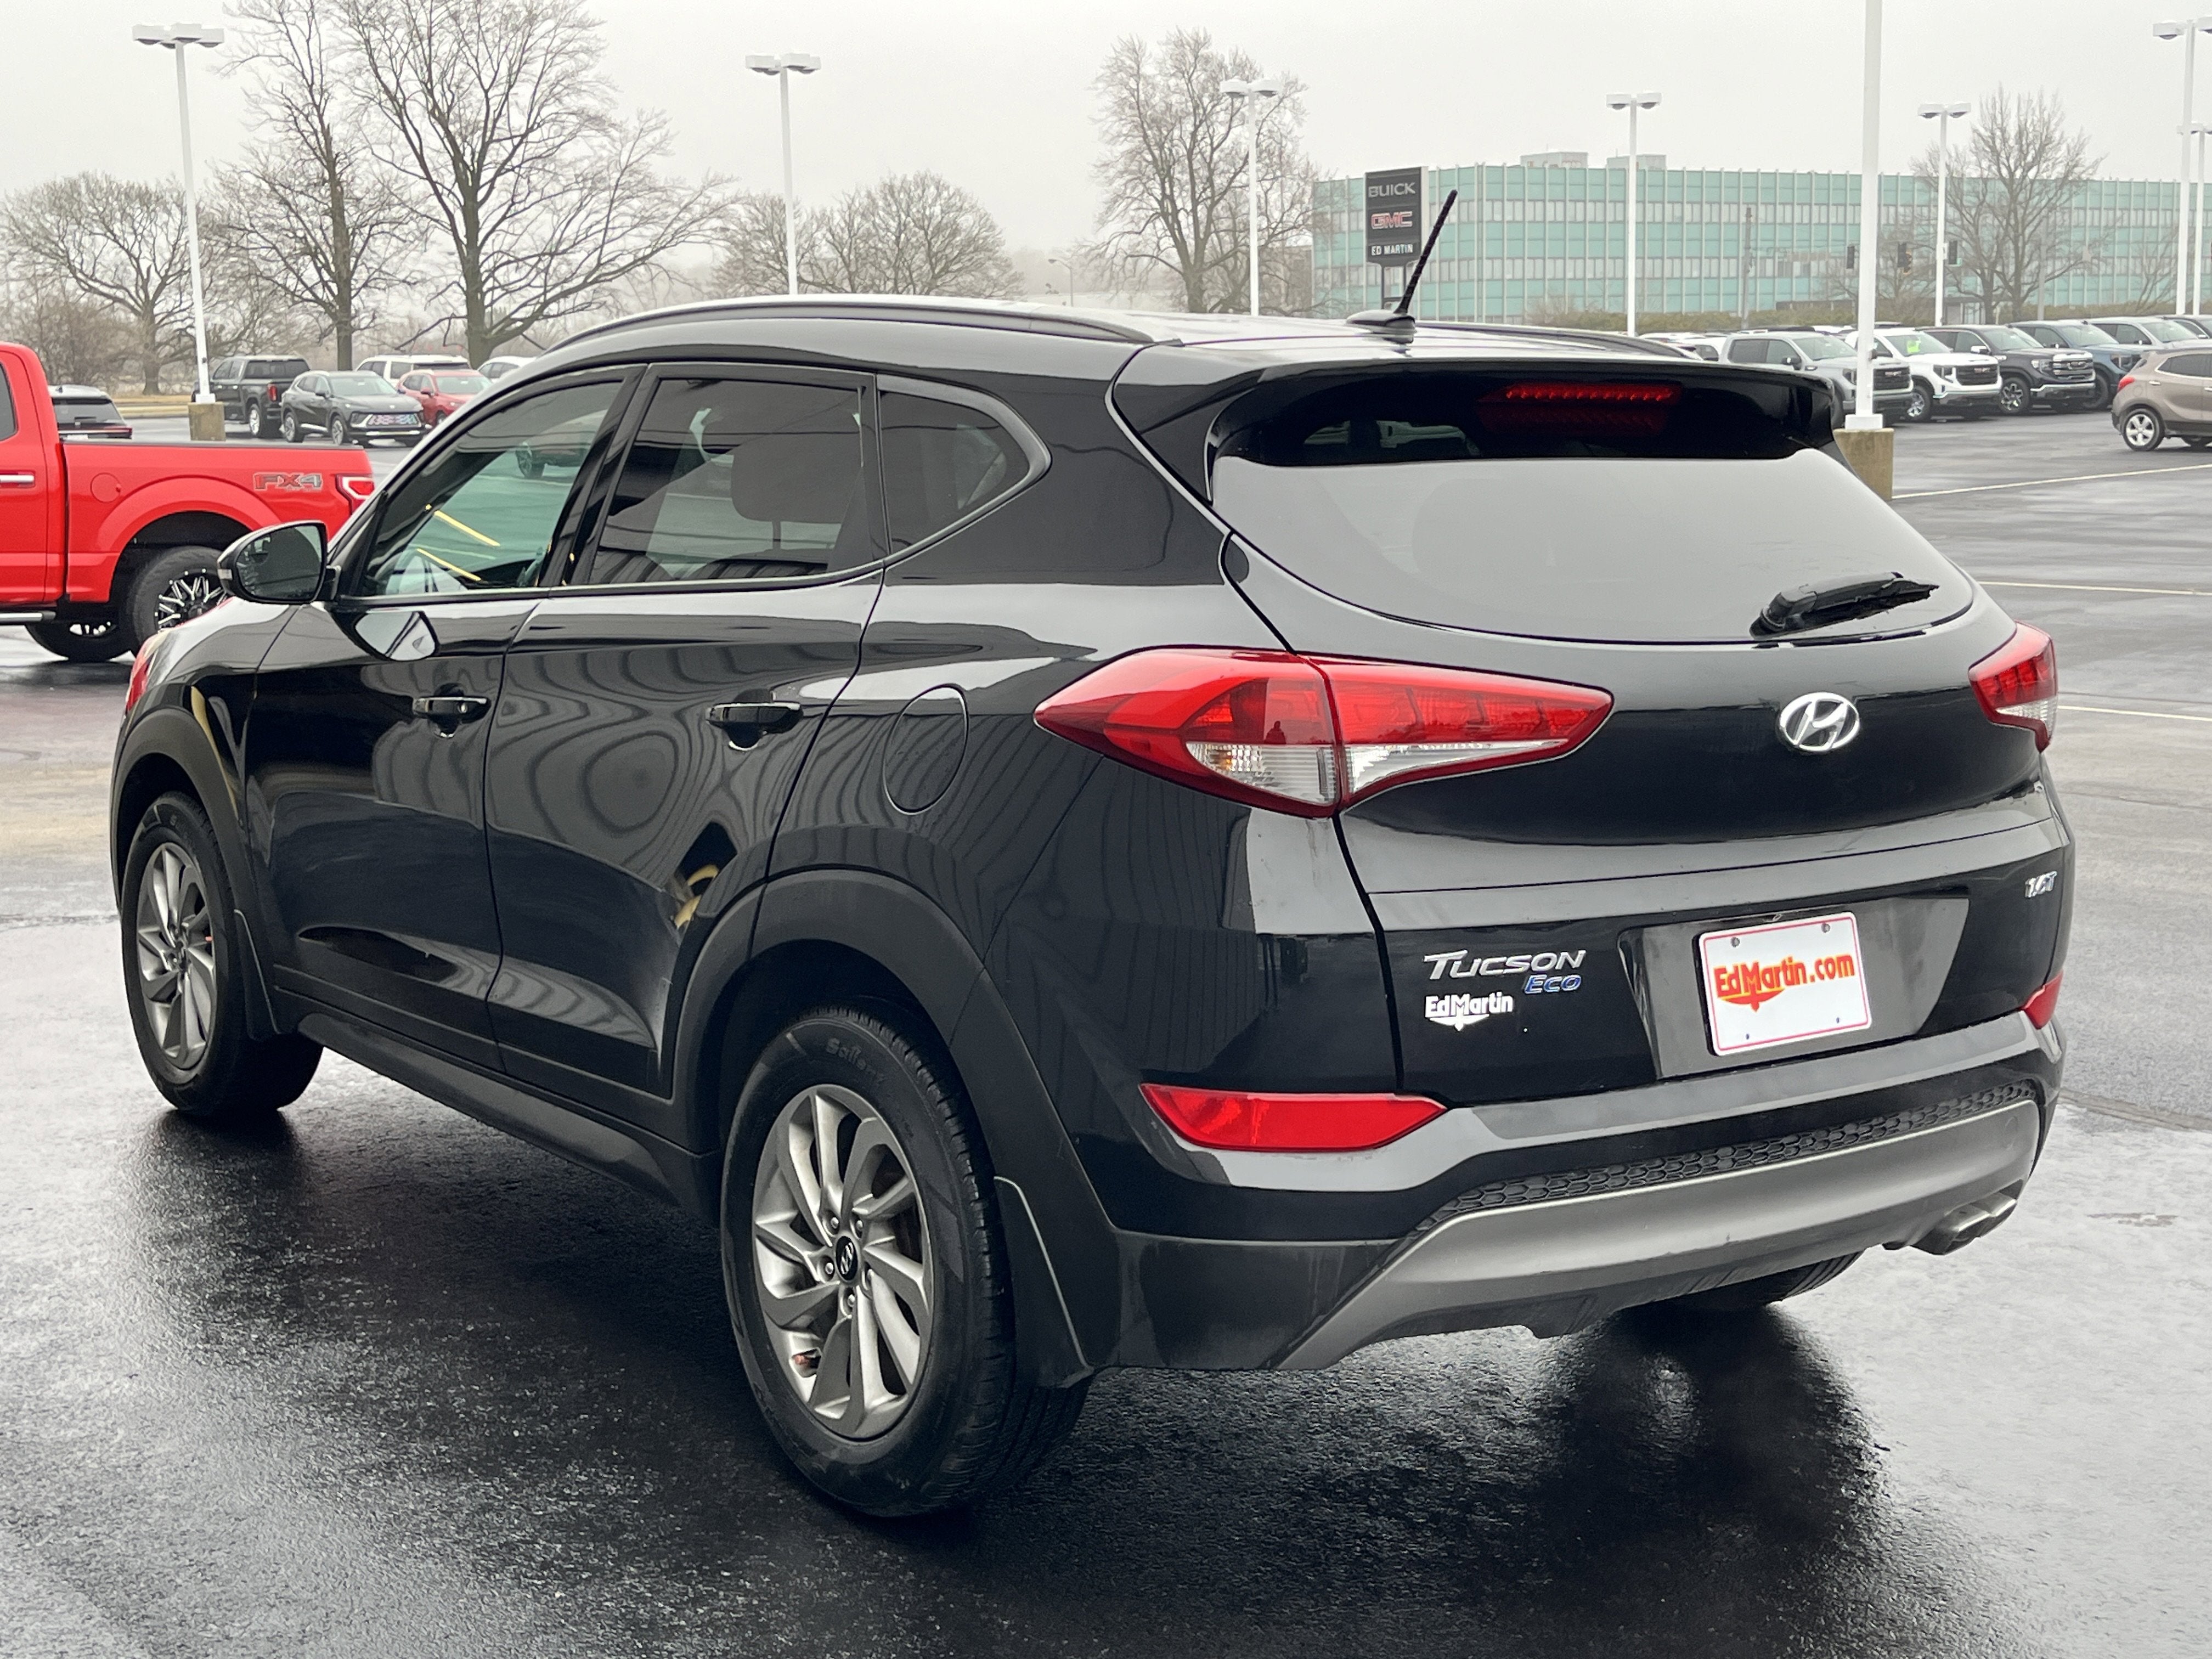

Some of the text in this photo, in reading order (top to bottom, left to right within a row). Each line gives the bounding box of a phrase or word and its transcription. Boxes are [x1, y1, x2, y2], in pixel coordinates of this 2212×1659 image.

[1368, 182, 1415, 198] BUICK
[1371, 211, 1413, 230] GMC
[1372, 244, 1413, 256] ED MARTIN
[253, 472, 323, 490] FX4
[1424, 950, 1586, 979] TUCSON
[1713, 955, 1855, 998] EdMartin.com
[1425, 991, 1513, 1018] EdMartin
